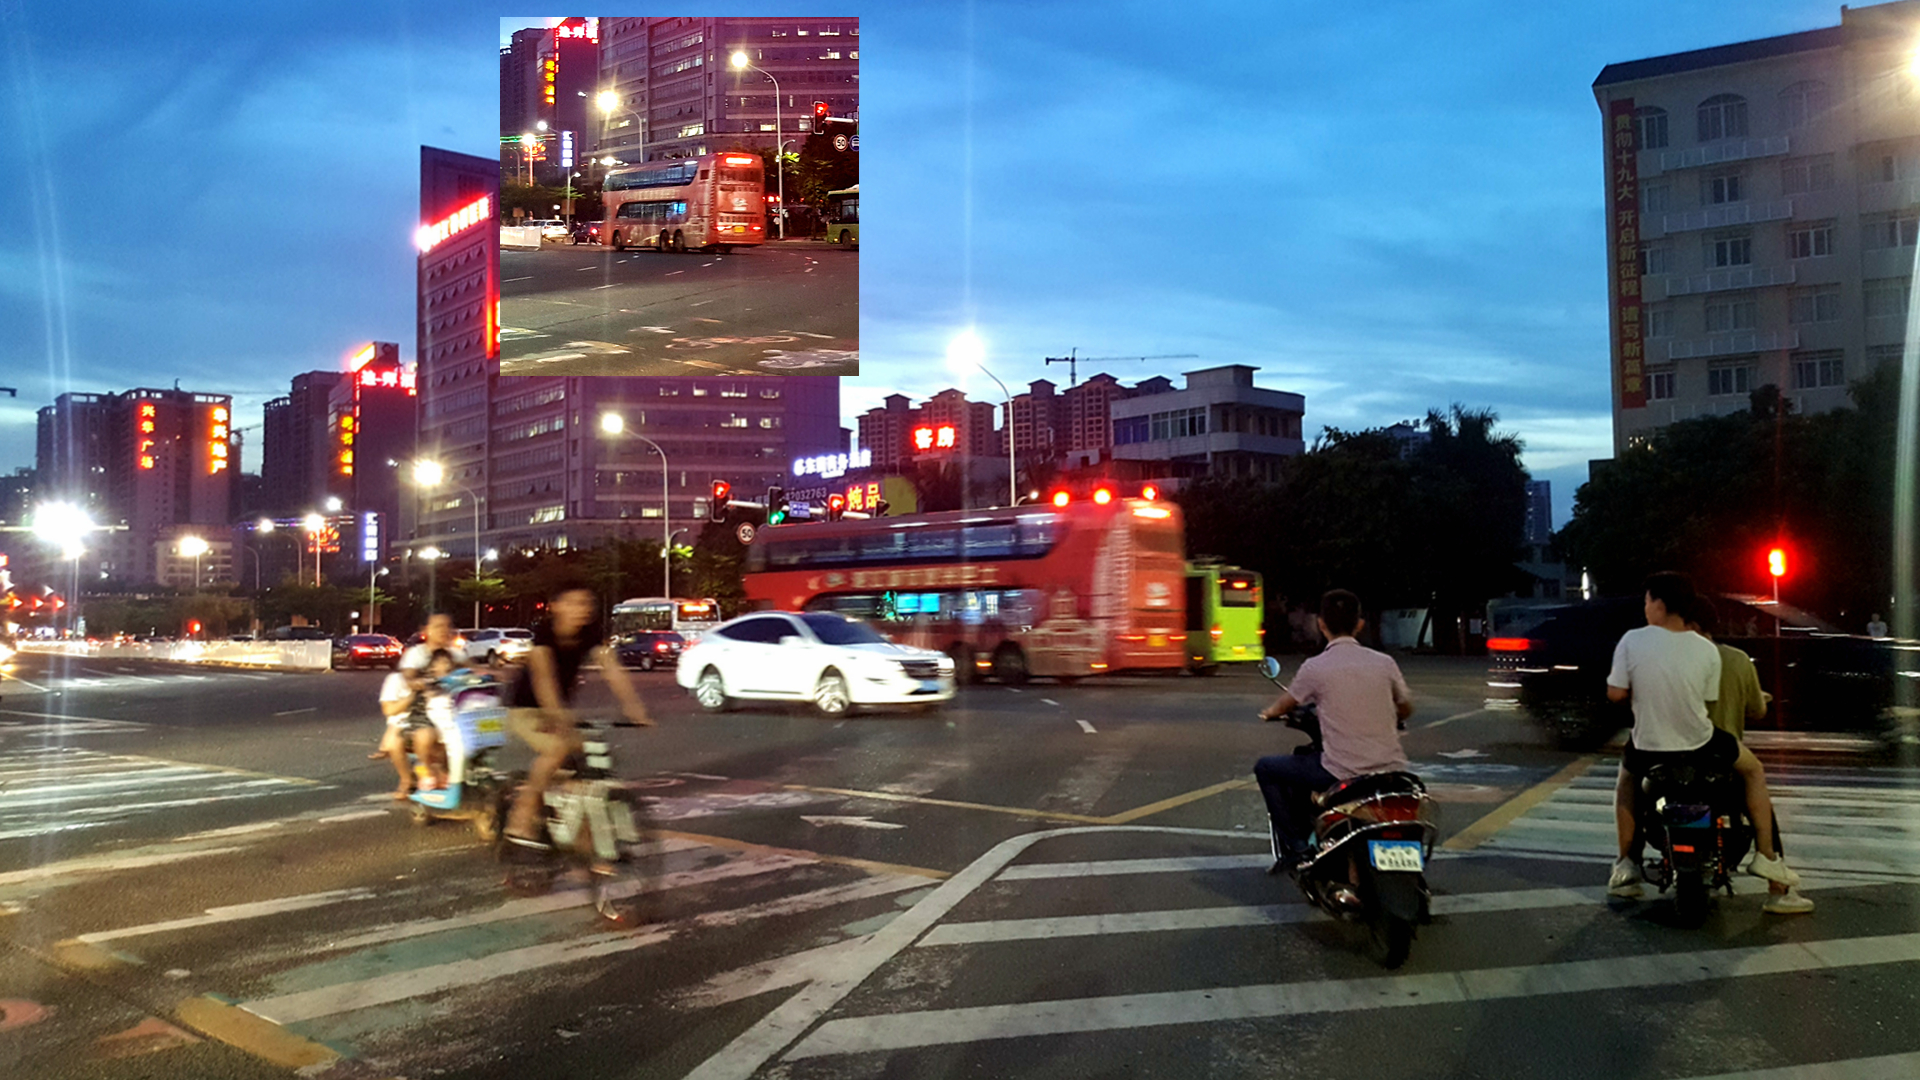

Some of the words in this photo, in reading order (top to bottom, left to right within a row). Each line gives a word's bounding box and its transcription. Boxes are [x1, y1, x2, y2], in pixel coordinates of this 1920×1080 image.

[1613, 113, 1635, 202] 贯彻十九大
[1617, 210, 1639, 297] 开启新征程
[1622, 306, 1642, 393] 谱写新篇章
[140, 404, 156, 470] 兴华广场
[914, 426, 957, 449] 客房
[741, 528, 753, 539] 50
